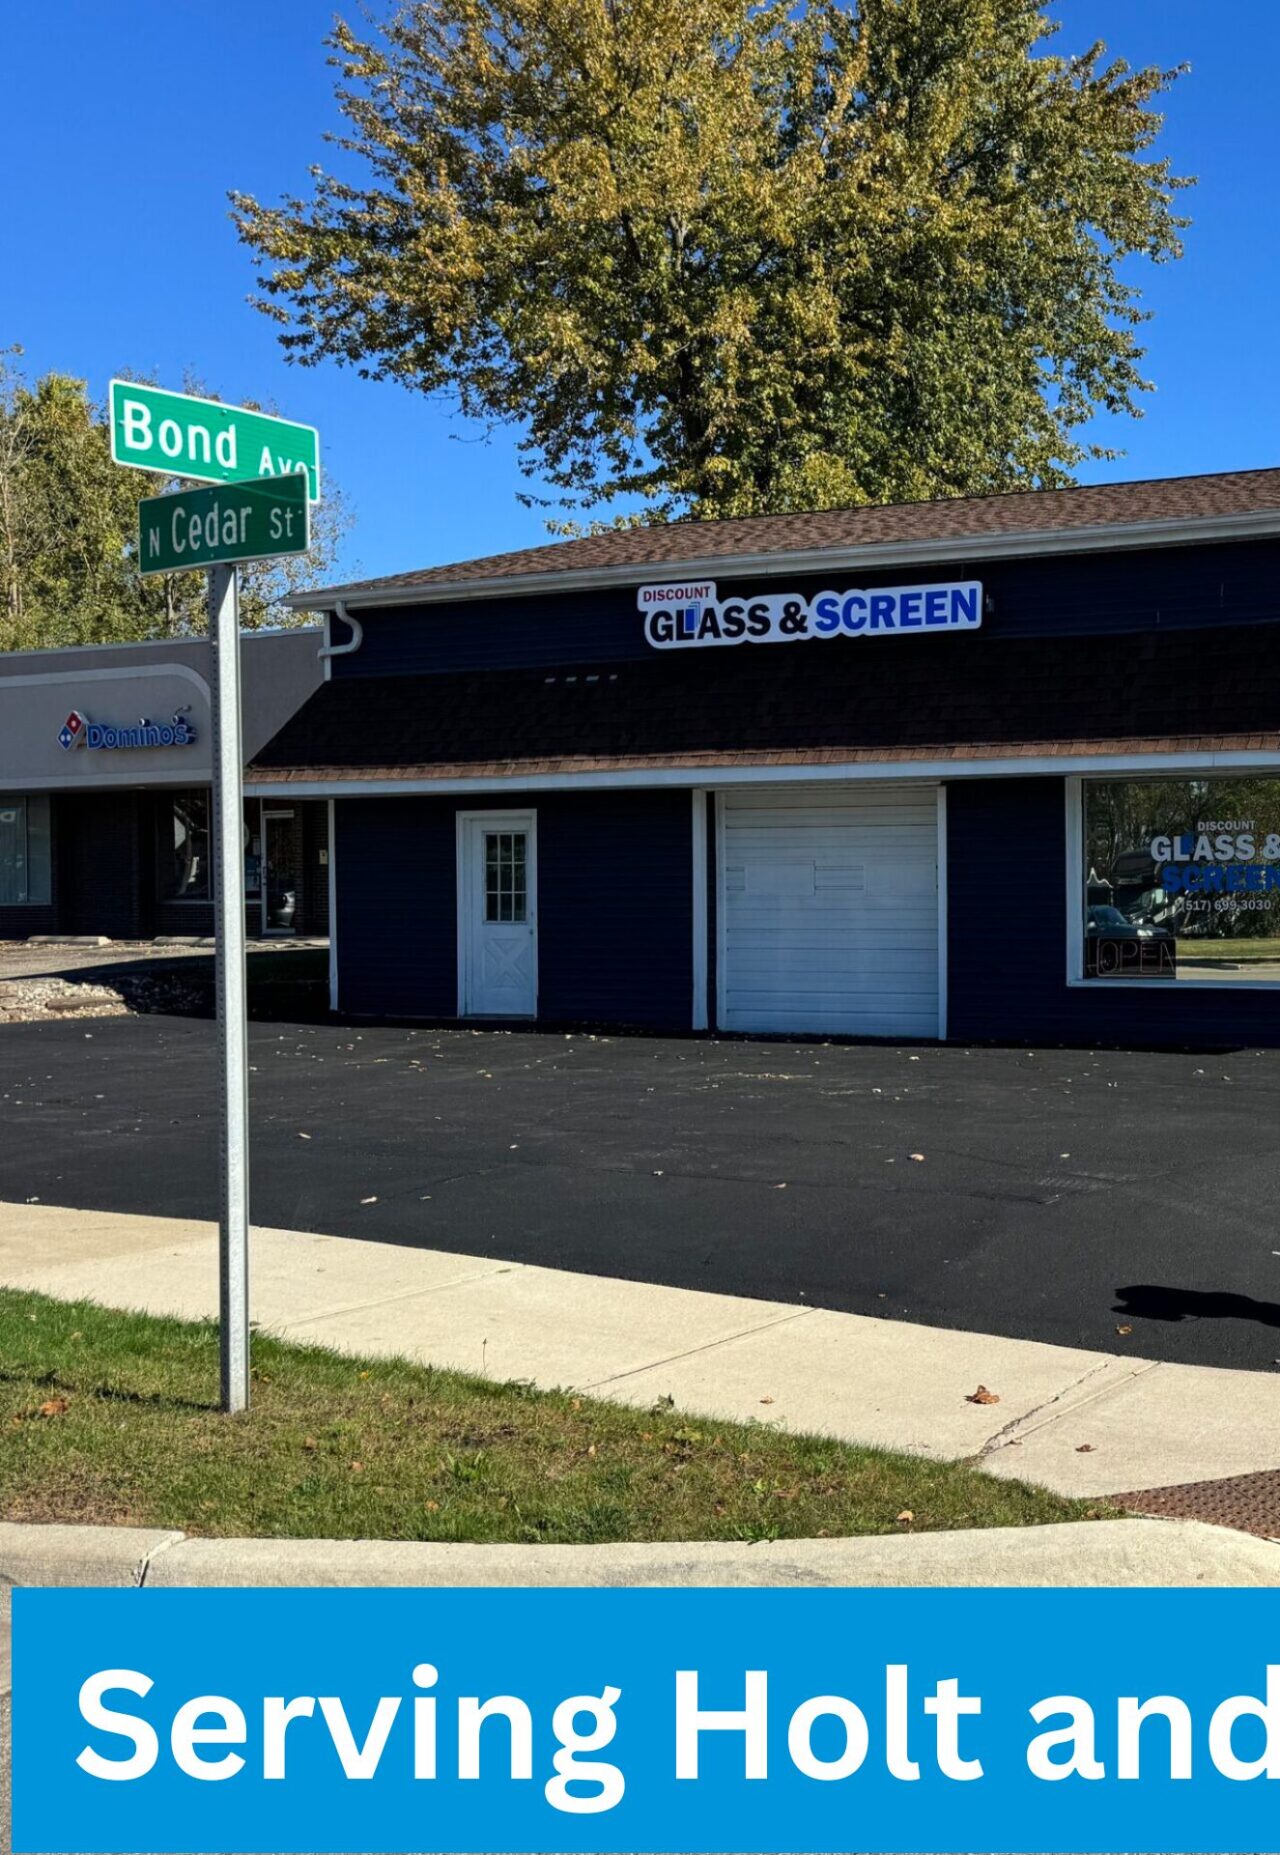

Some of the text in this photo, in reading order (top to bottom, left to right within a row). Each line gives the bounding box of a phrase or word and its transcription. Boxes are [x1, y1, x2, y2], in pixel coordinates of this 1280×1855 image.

[123, 399, 237, 469] Bond
[149, 501, 293, 557] N Cedar St
[643, 586, 710, 603] DISCOUNT
[649, 588, 977, 642] GLASS & SCREEN
[87, 715, 192, 749] Domino's
[1197, 820, 1255, 831] DISCOUNT
[1150, 834, 1255, 862] GLASS
[1181, 899, 1211, 912] (517)
[1099, 941, 1175, 973] OPEN
